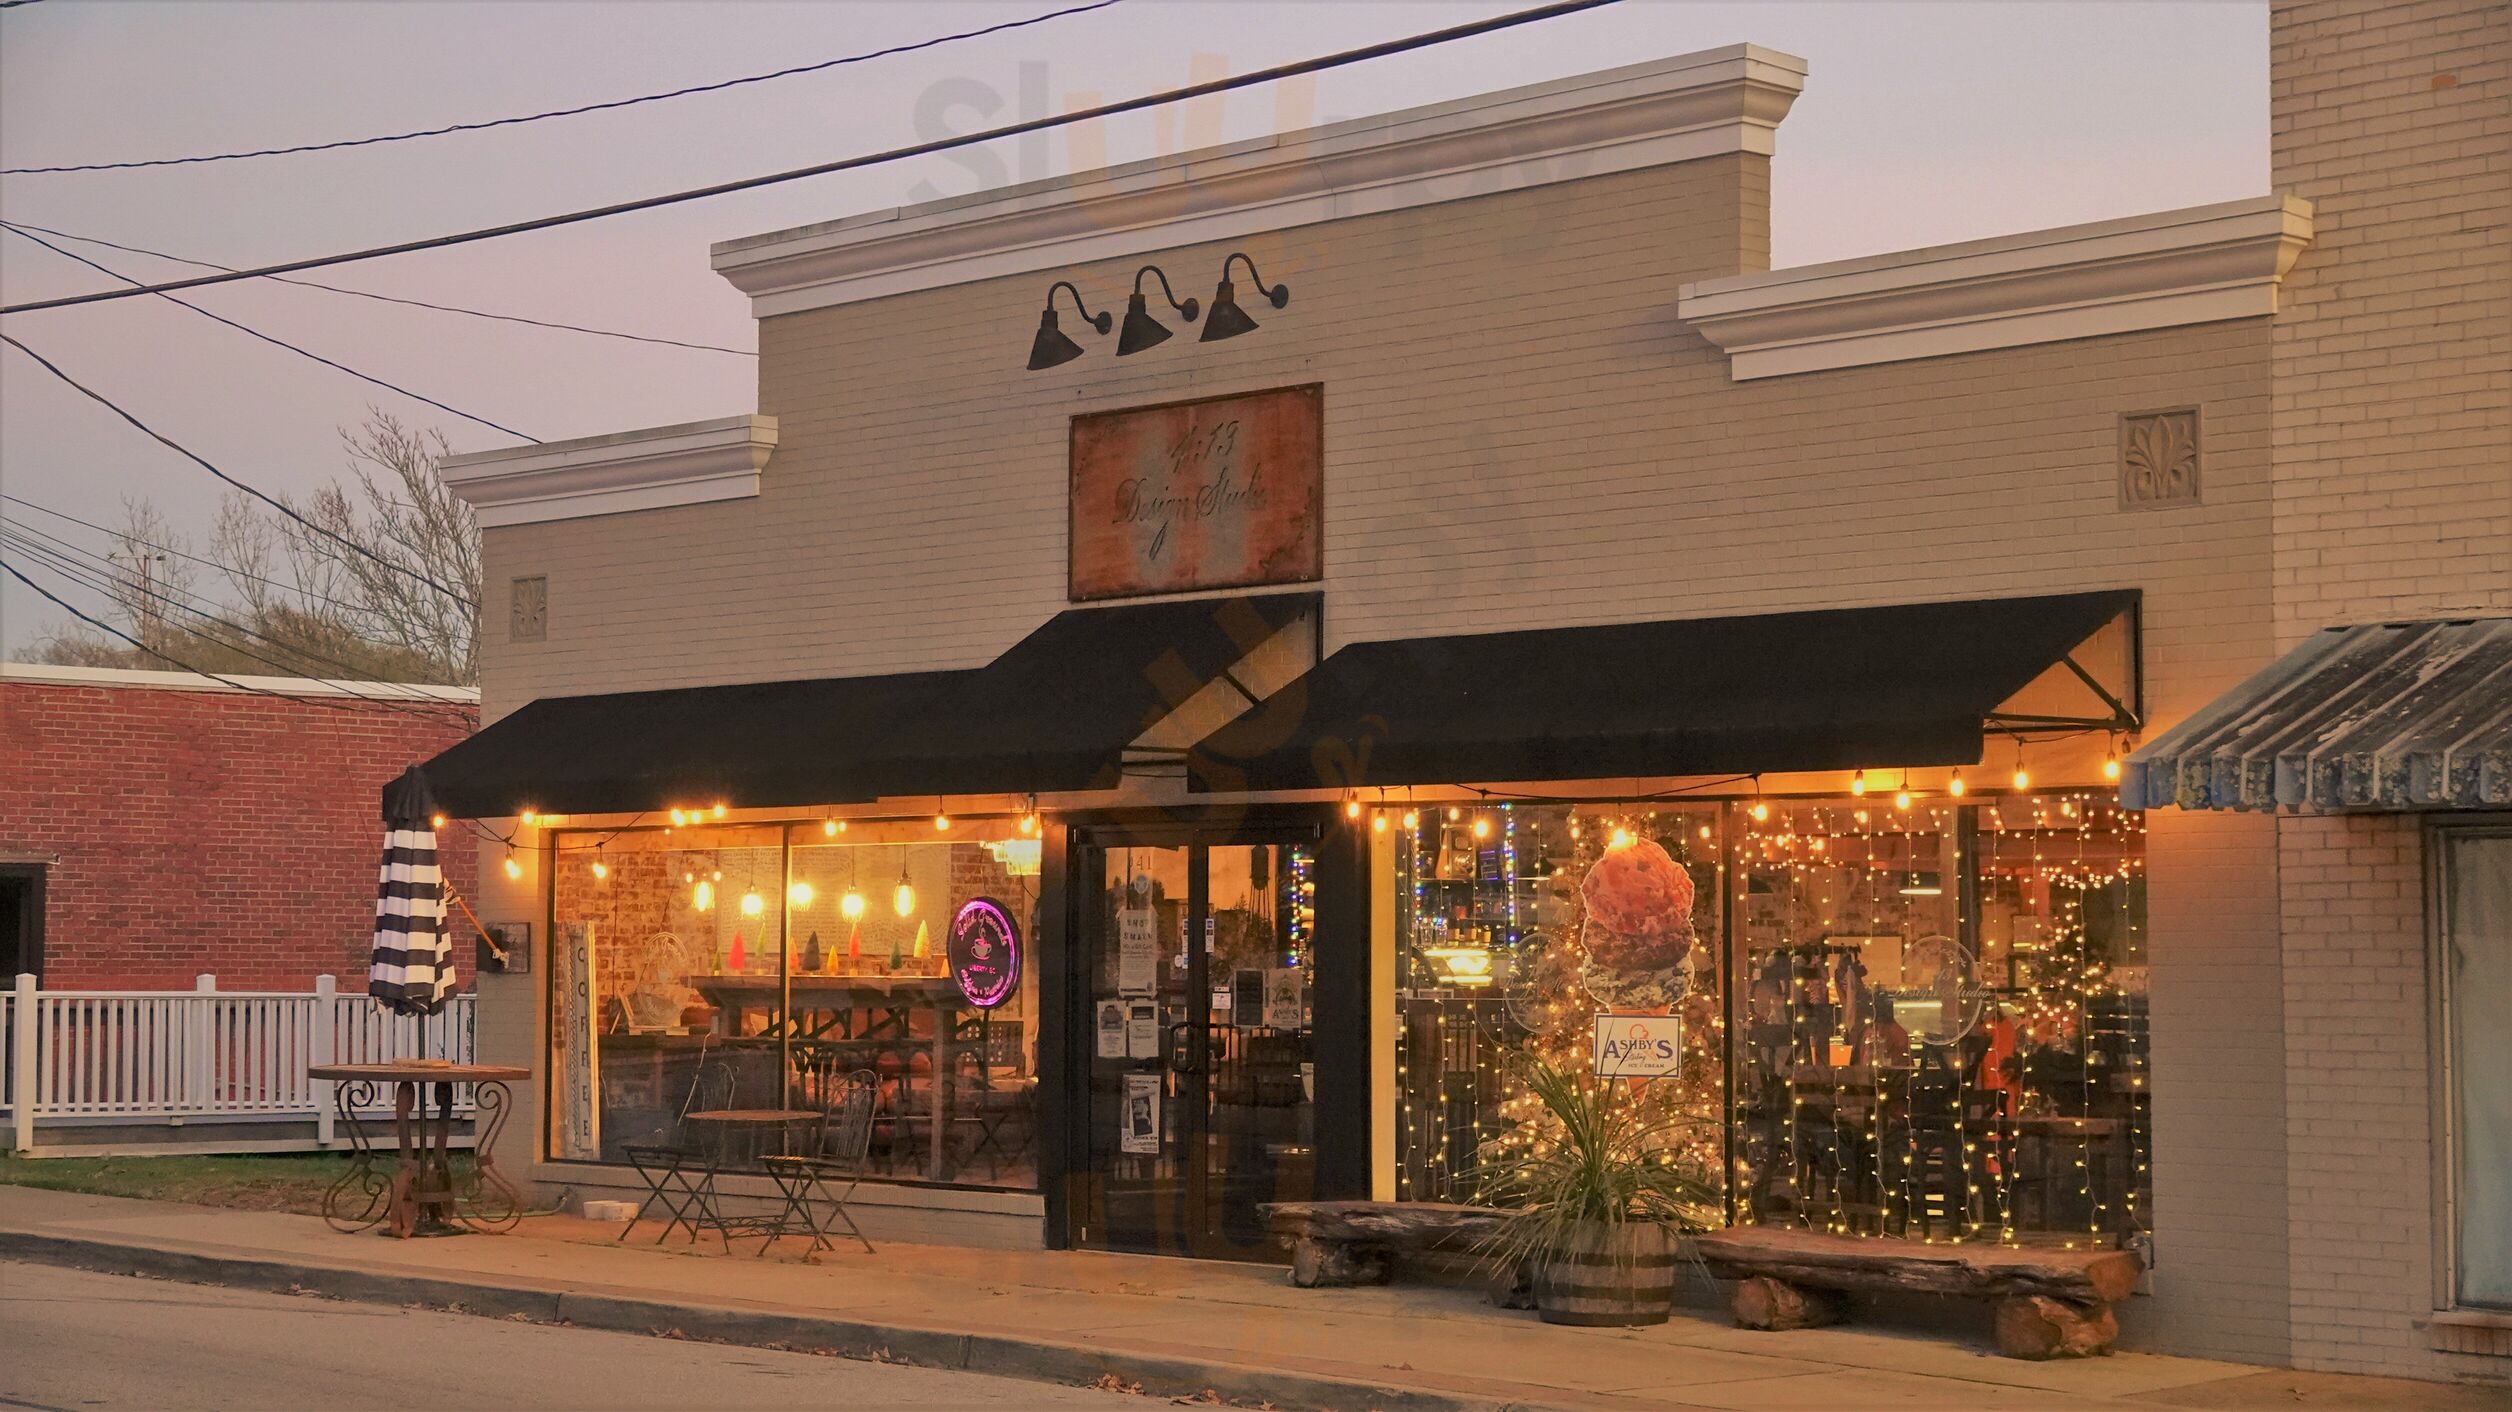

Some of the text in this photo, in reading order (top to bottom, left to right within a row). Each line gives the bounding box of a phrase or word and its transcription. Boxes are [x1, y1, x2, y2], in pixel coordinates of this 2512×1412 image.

[1112, 477, 1191, 561] Design
[577, 947, 589, 1136] COFFEE
[1603, 1039, 1674, 1060] ASHBY'S
